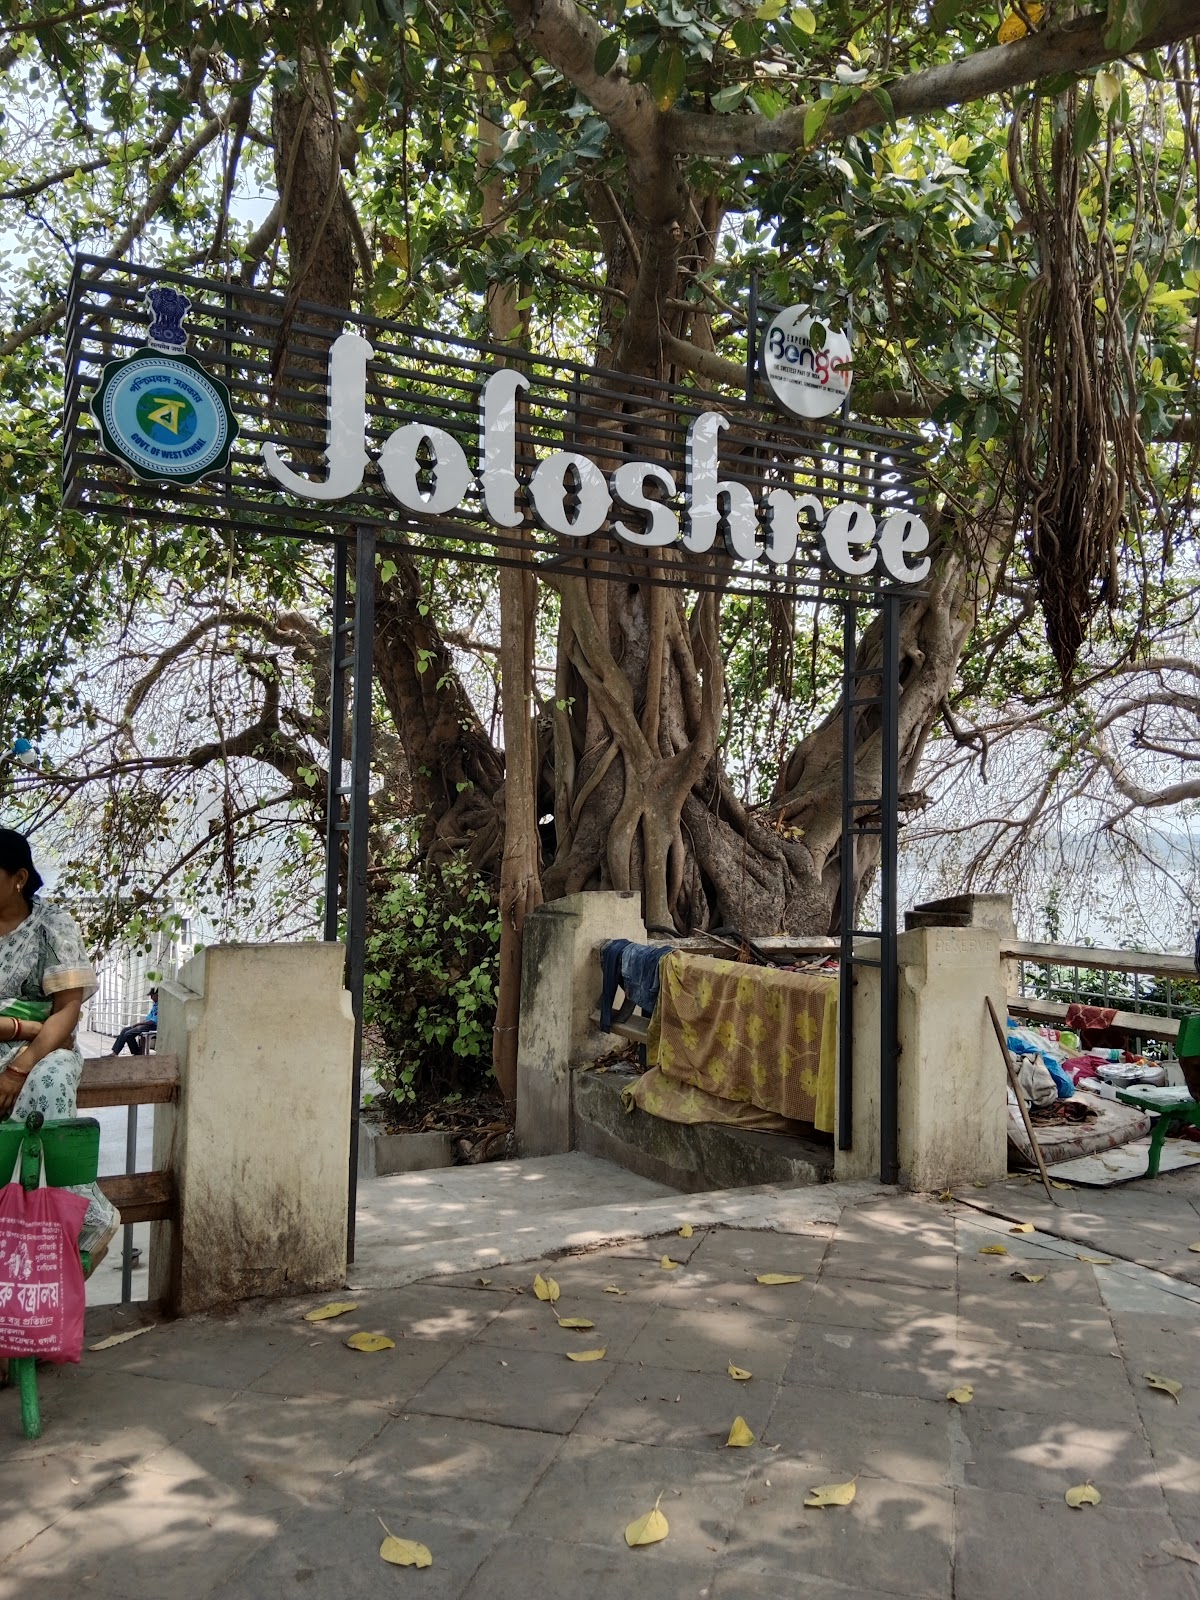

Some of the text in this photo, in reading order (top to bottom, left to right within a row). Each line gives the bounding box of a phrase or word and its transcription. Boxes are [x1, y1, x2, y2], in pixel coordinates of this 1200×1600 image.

[770, 327, 849, 387] Bengal
[780, 365, 797, 374] SWEETEST
[130, 375, 203, 403] পশ্চিমবঙ্গ সরকার
[130, 432, 206, 459] GOVT. OF WEST BENGAL
[261, 333, 933, 584] Joloshree
[17, 1280, 59, 1314] বস্ত্রালয়
[22, 1315, 54, 1326] প্রতিষ্ঠান
